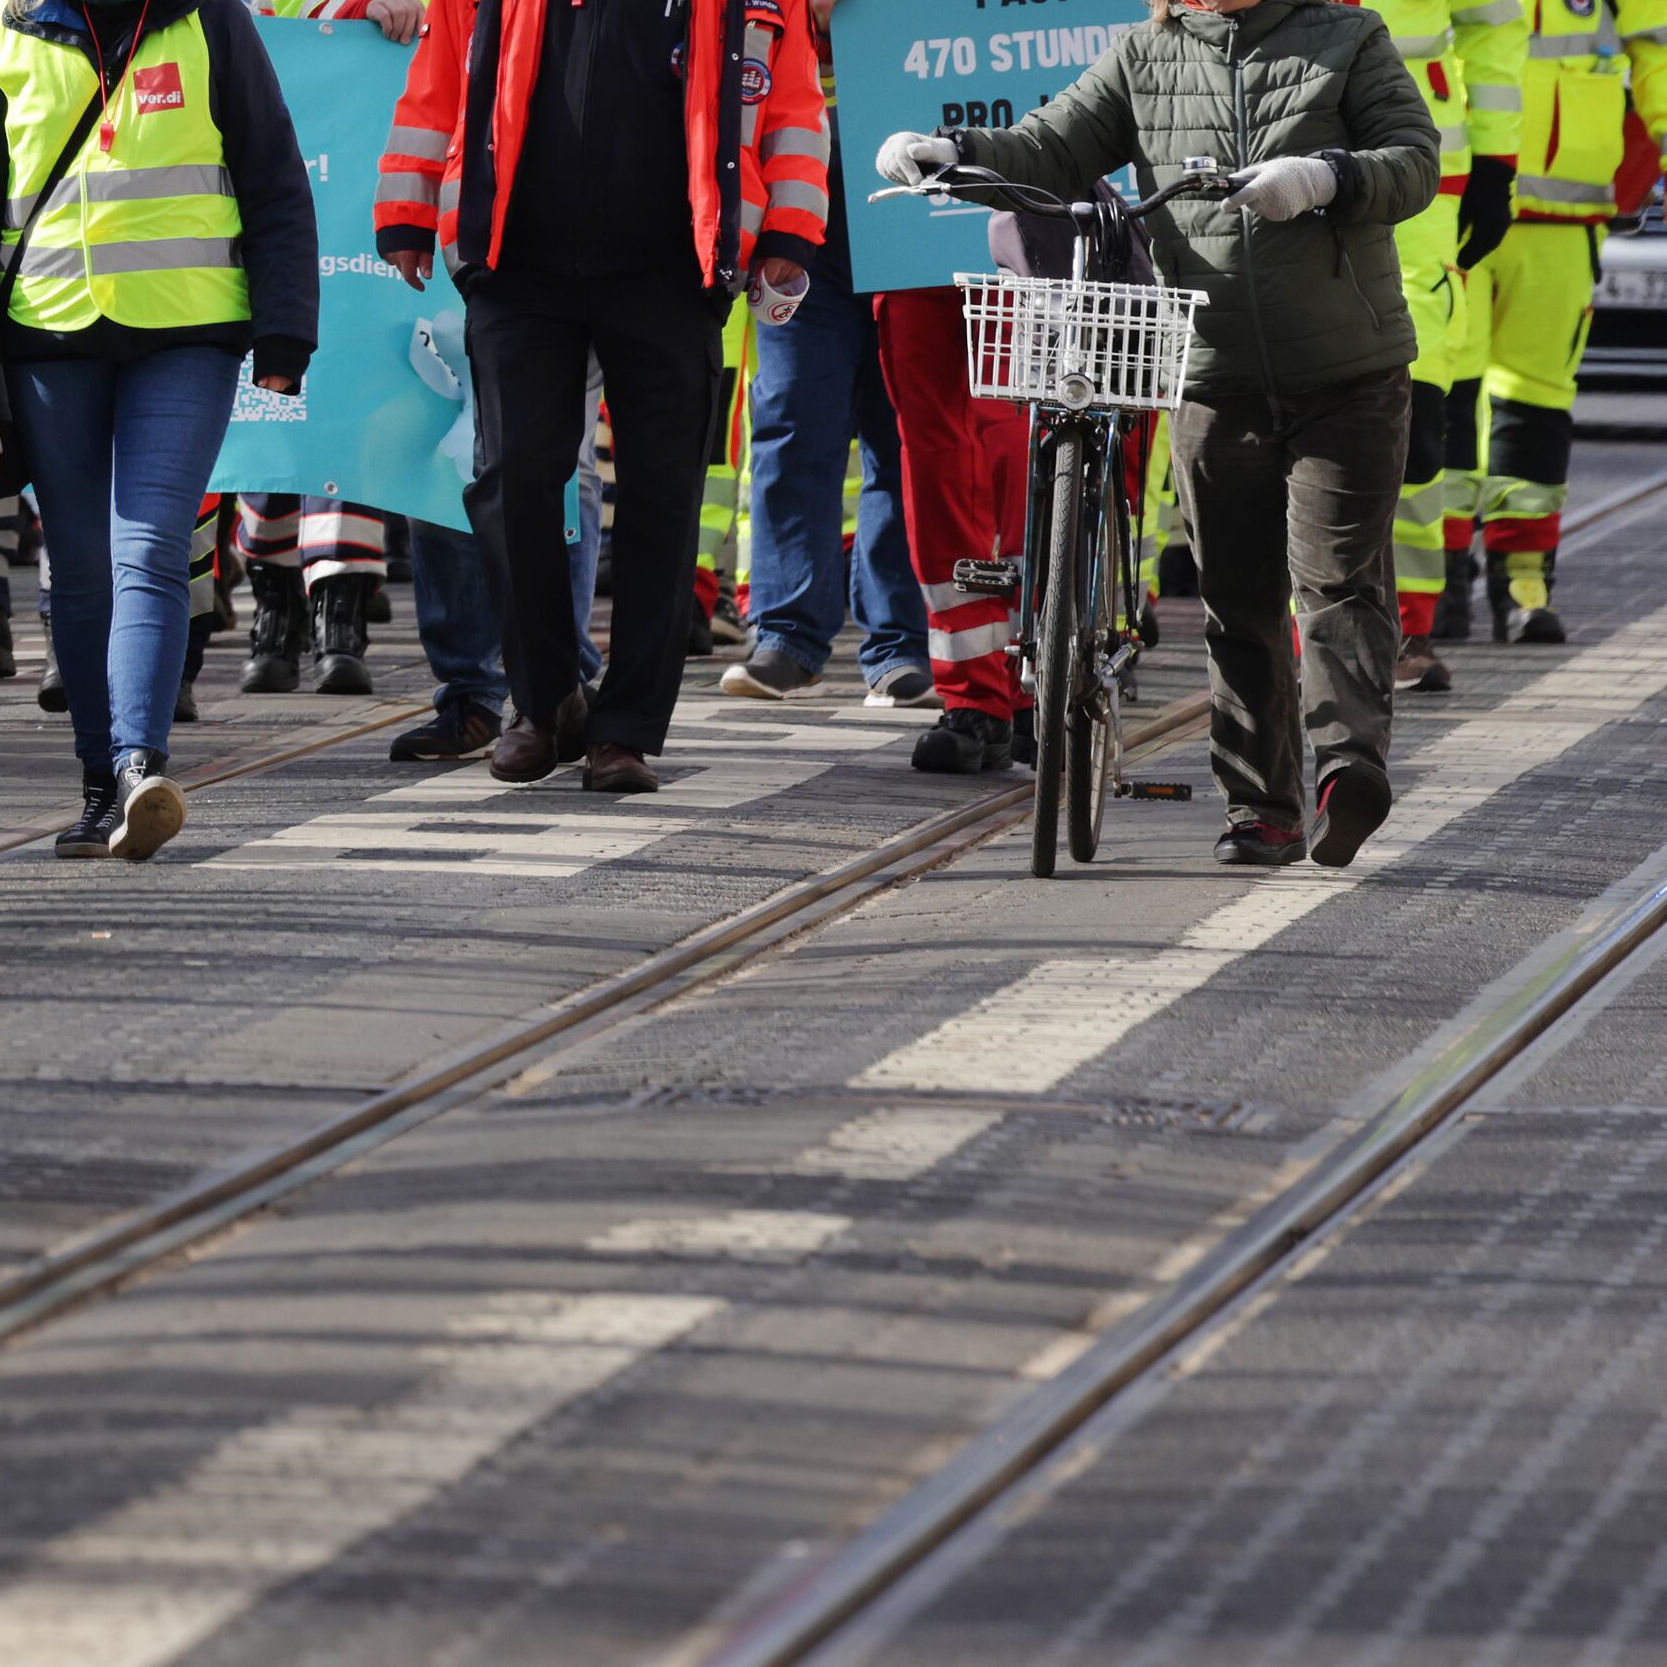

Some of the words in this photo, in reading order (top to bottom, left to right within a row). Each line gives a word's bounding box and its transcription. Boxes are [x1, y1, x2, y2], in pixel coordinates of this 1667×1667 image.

[752, 0, 778, 11] Wunder
[904, 36, 977, 80] 470
[138, 91, 182, 105] ver.di
[942, 98, 1015, 130] PRO
[319, 252, 407, 281] gsdien
